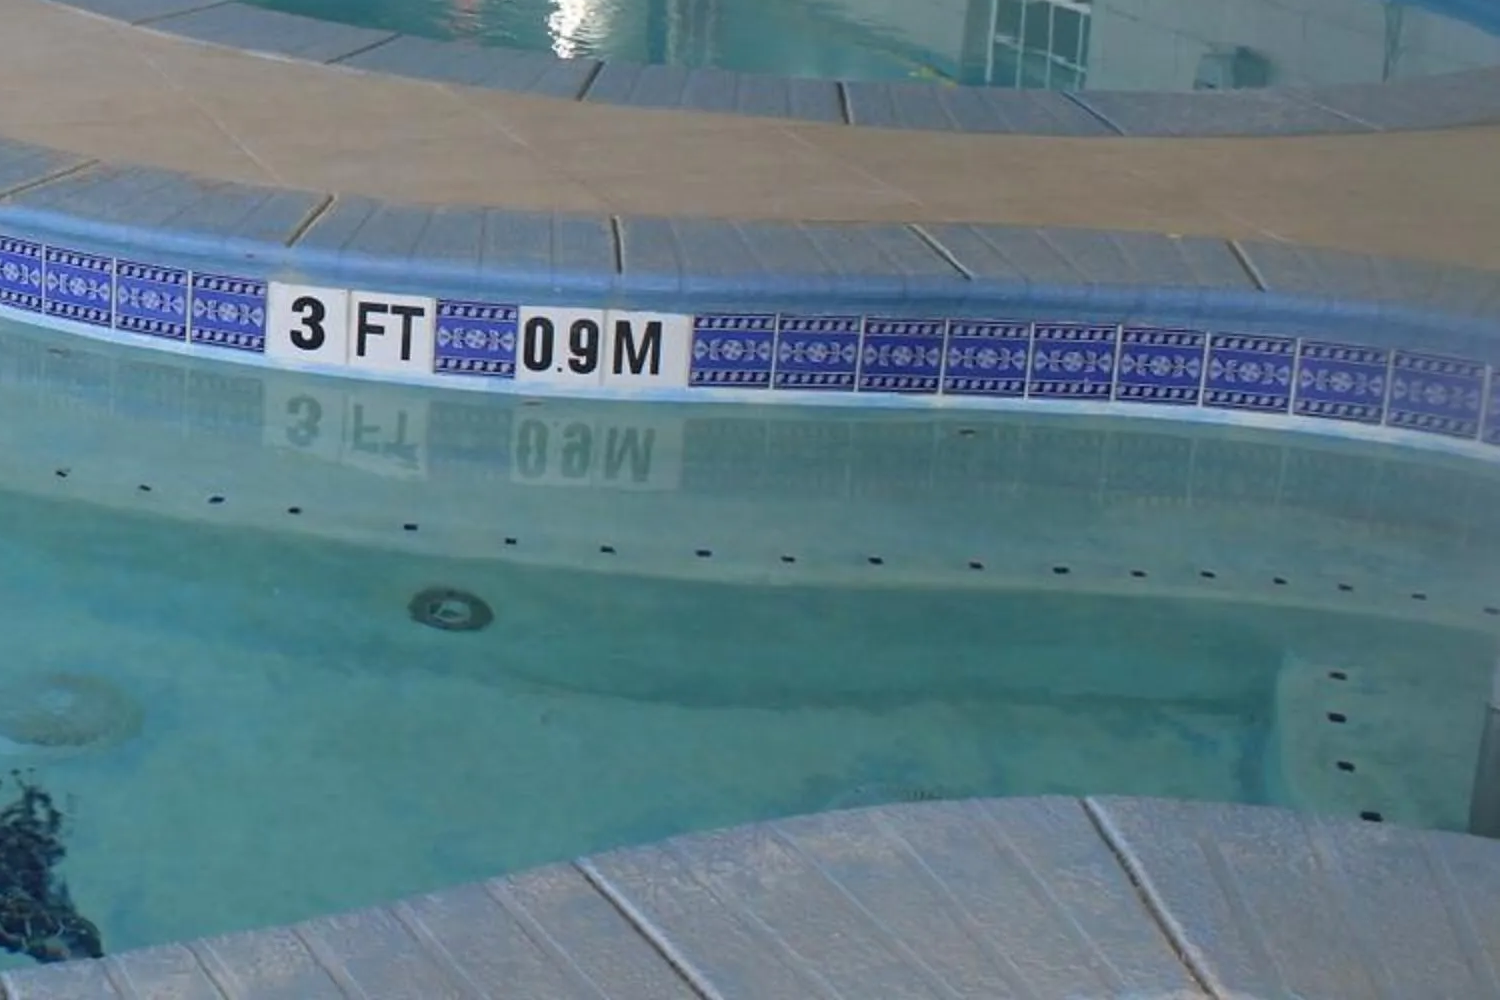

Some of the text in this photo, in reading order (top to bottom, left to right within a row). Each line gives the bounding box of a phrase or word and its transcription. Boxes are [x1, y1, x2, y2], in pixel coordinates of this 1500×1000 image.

[289, 296, 664, 376] 3 FT 0.9M
